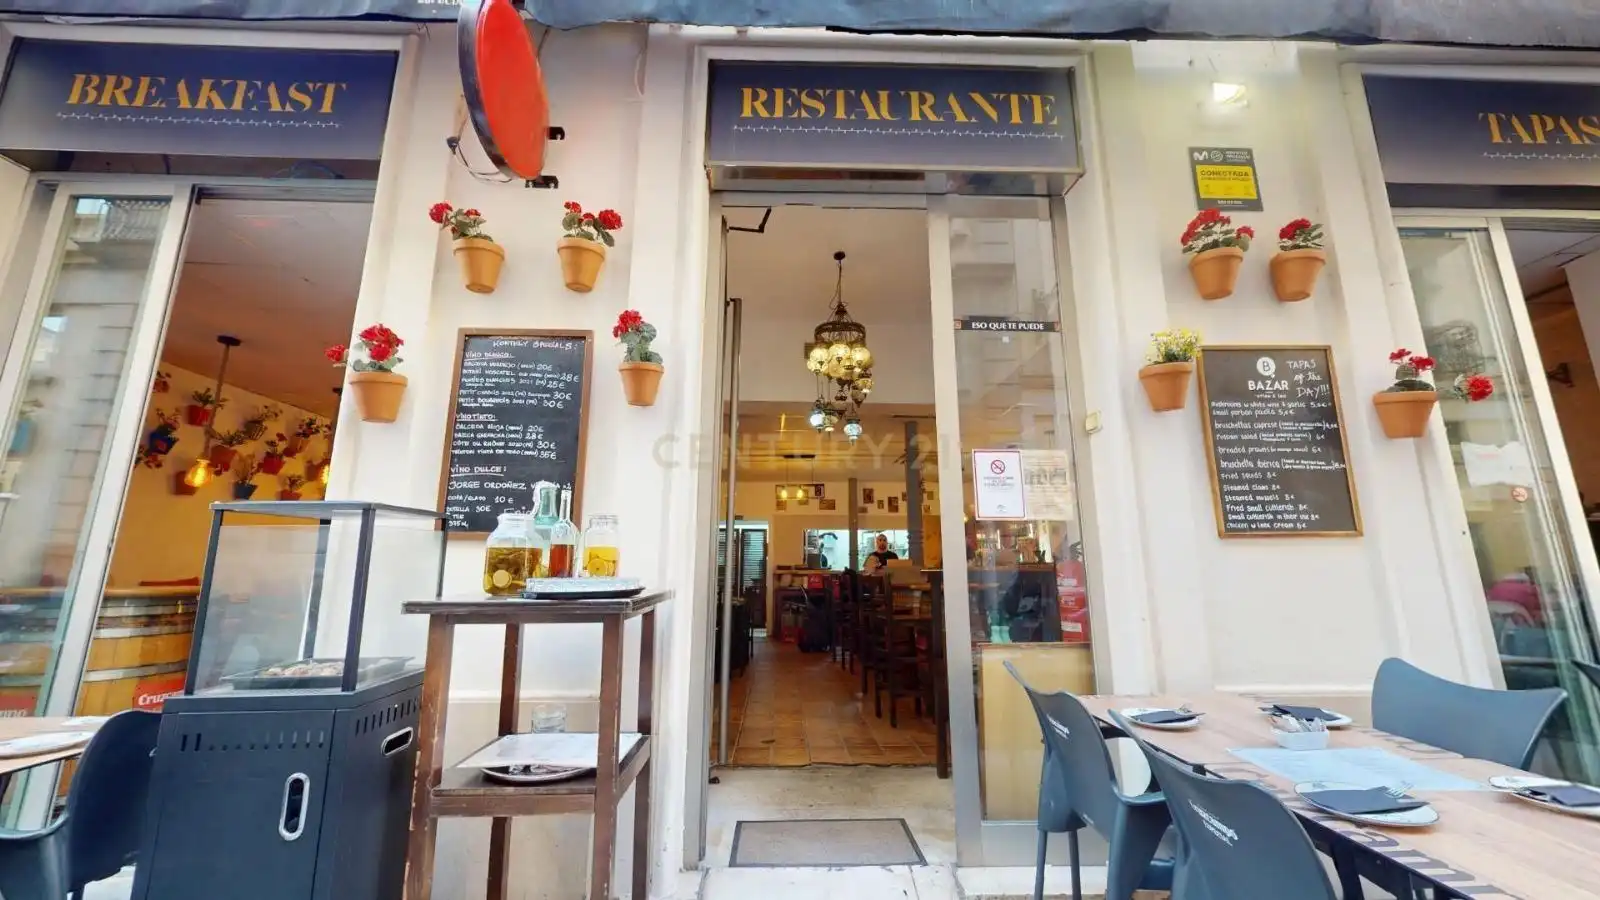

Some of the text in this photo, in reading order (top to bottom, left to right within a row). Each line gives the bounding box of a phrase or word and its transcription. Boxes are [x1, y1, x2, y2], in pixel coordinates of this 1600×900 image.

[66, 73, 347, 113] BREAKFAST
[740, 87, 1058, 125] RESTAURANTE
[1478, 112, 1600, 145] TAPAS
[971, 321, 1045, 330] ESO QUE TE PUEDE
[1248, 380, 1289, 391] BAZAR
[448, 480, 480, 490] JORGE
